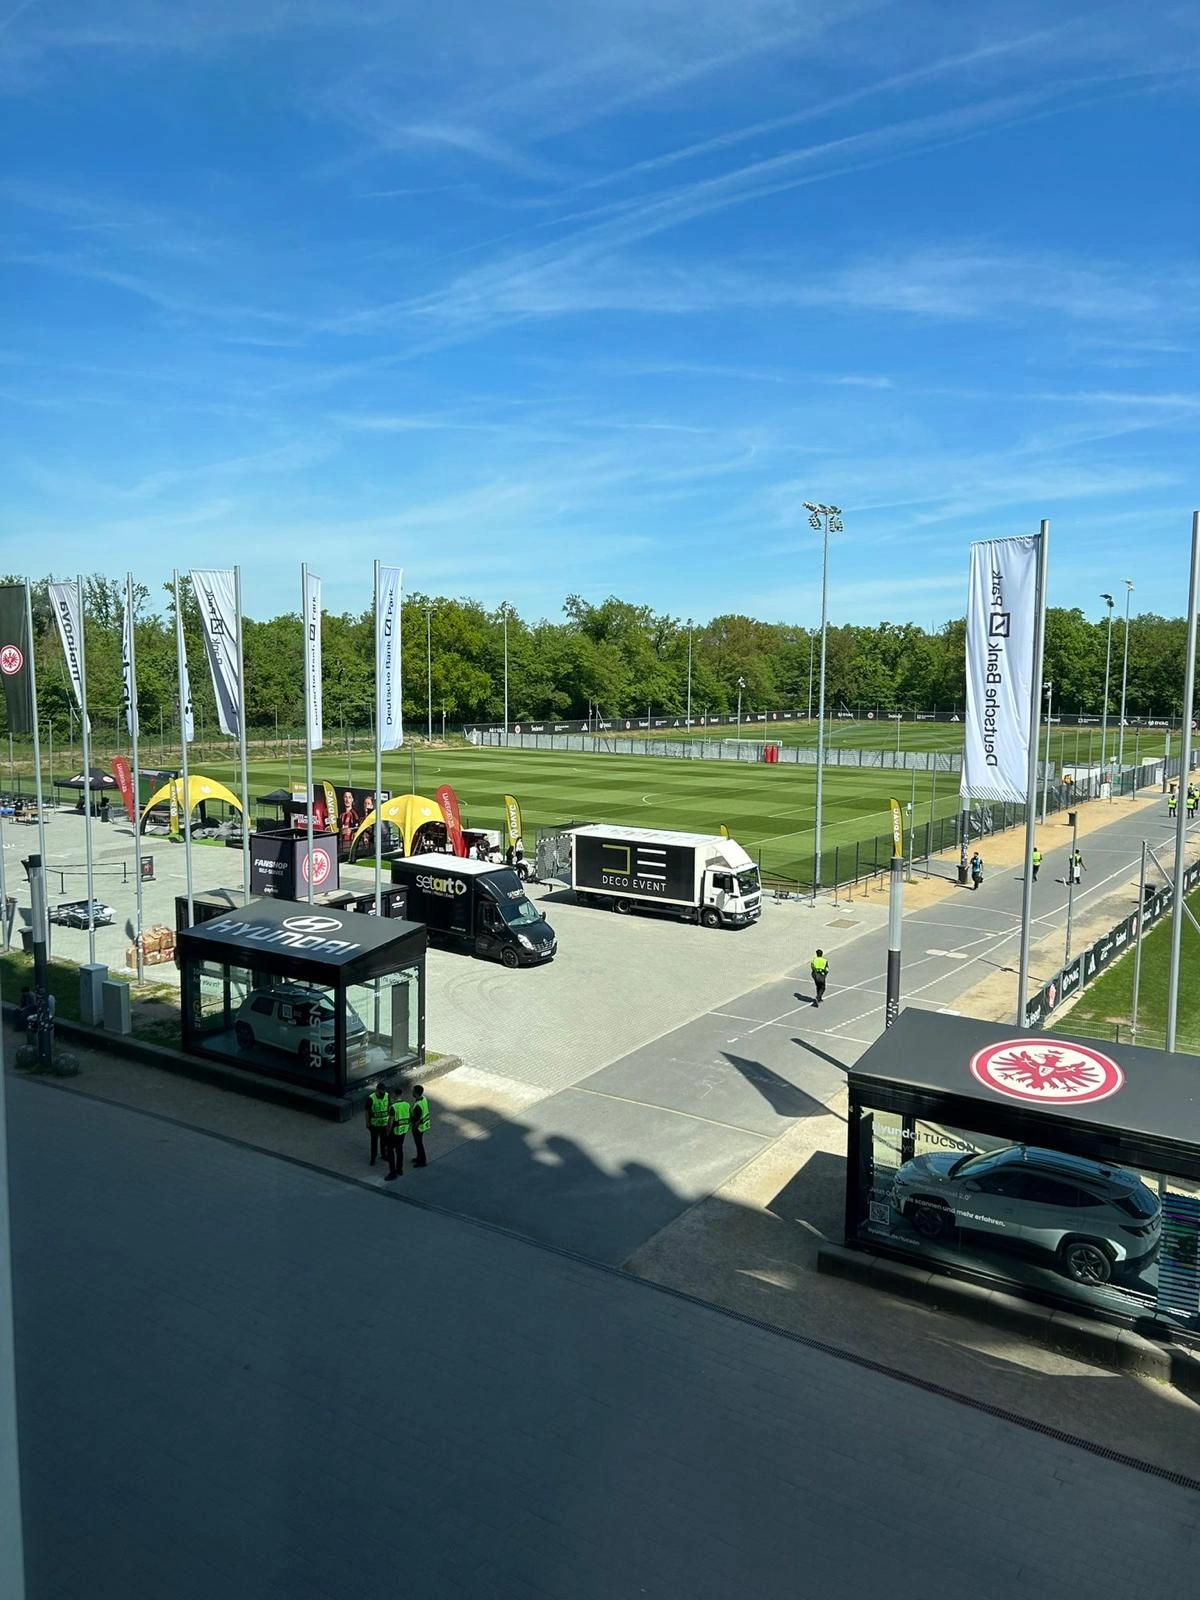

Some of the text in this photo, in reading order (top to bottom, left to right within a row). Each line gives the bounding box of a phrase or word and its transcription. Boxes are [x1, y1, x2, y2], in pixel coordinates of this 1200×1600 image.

[254, 858, 288, 869] FANSHOP
[602, 875, 667, 892] DECO EVENT
[206, 919, 361, 956] HYUNDAI
[923, 1133, 977, 1153] TUCSON
[915, 1198, 942, 1210] scannen
[942, 1203, 956, 1214] und
[956, 1208, 974, 1219] mehr
[974, 1213, 1006, 1227] erfahren.
